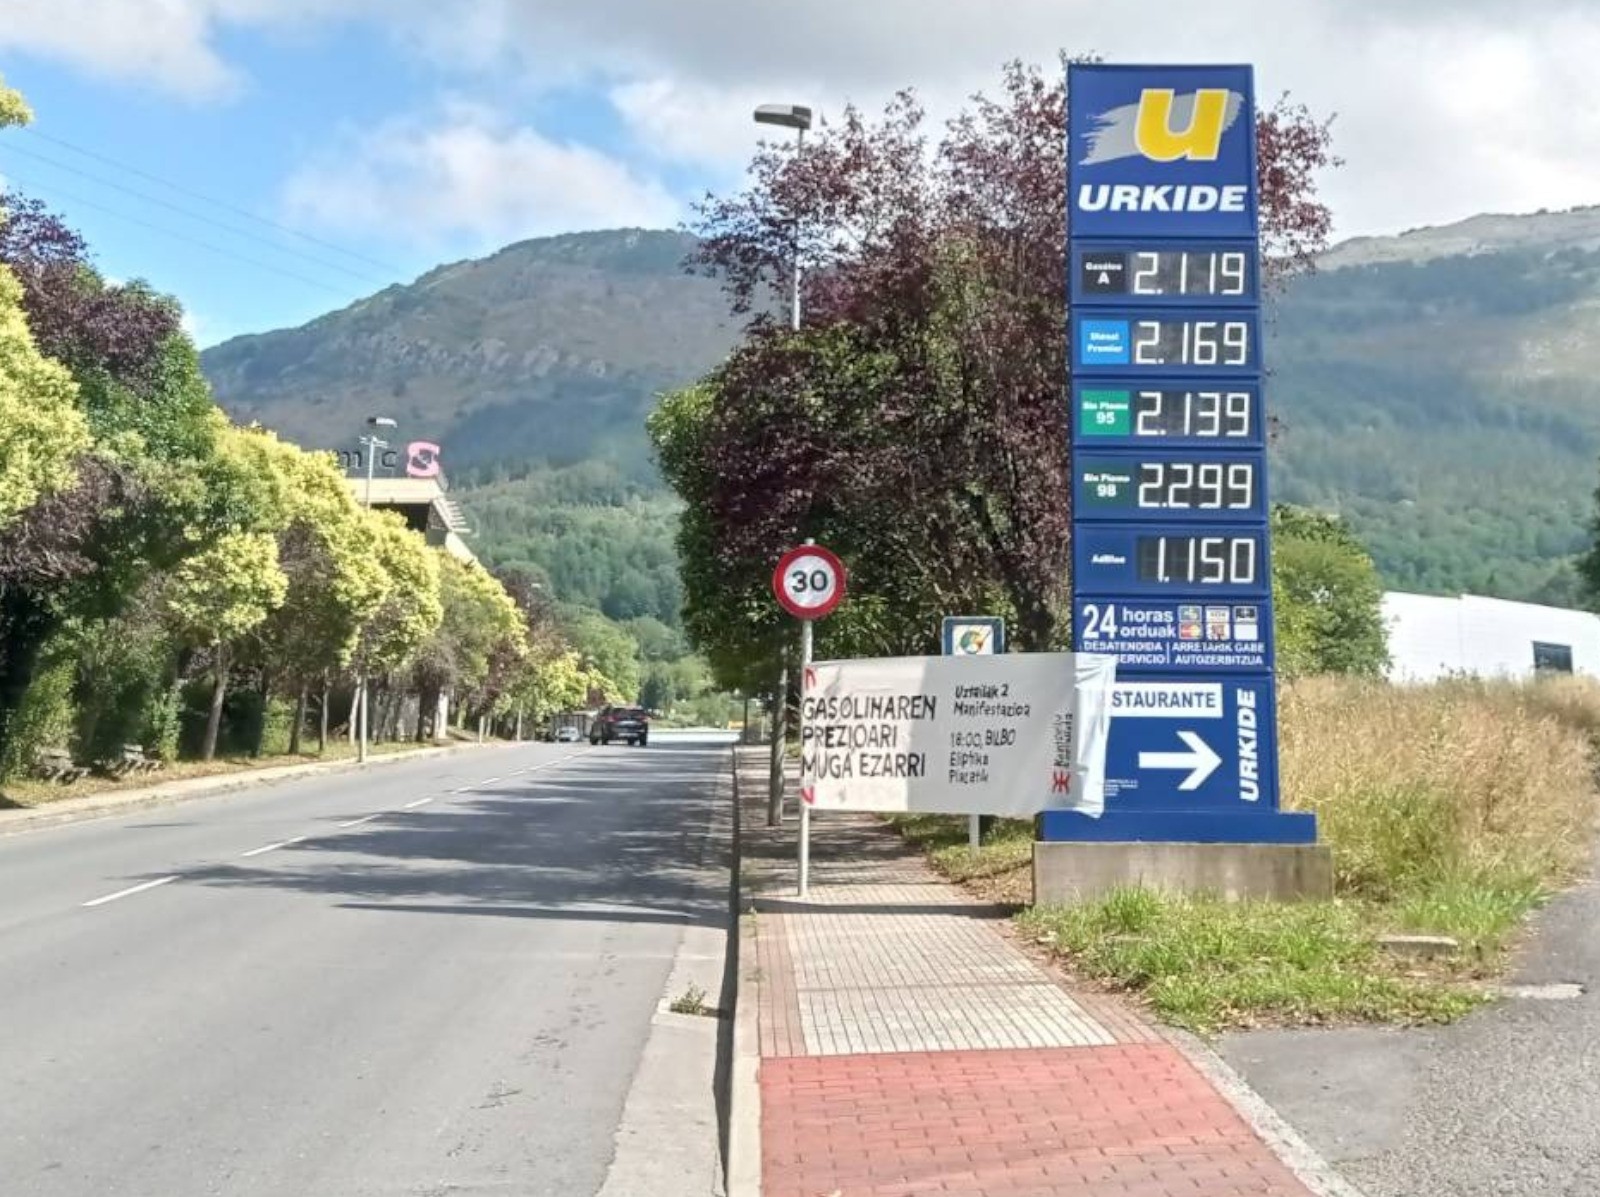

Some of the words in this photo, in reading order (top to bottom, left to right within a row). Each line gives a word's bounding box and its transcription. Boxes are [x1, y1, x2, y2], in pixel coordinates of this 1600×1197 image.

[1078, 184, 1248, 212] URKIDE
[1098, 272, 1110, 284] A
[1133, 252, 1245, 295] 2.119
[1135, 322, 1248, 365] 2.169
[1096, 411, 1115, 424] 95
[1137, 392, 1250, 437] 2.139
[1097, 484, 1117, 497] 98
[1138, 463, 1252, 509] 2.299
[1158, 537, 1255, 583] 1.150
[792, 569, 828, 592] 30
[1083, 604, 1118, 639] 24
[1122, 607, 1174, 623] horas
[1120, 624, 1177, 637] orduak
[1083, 641, 1163, 652] DESATENDIDA
[1234, 643, 1266, 653] GABE
[1001, 683, 1009, 697] 2
[1111, 691, 1216, 708] STAURANTE
[802, 695, 936, 721] GASOLINAREN
[802, 724, 897, 749] PREZIOARI
[985, 728, 1016, 746] BILBO
[1237, 688, 1260, 801] URKIDE
[801, 751, 852, 779] MUGA
[859, 752, 926, 777] EZARRI
